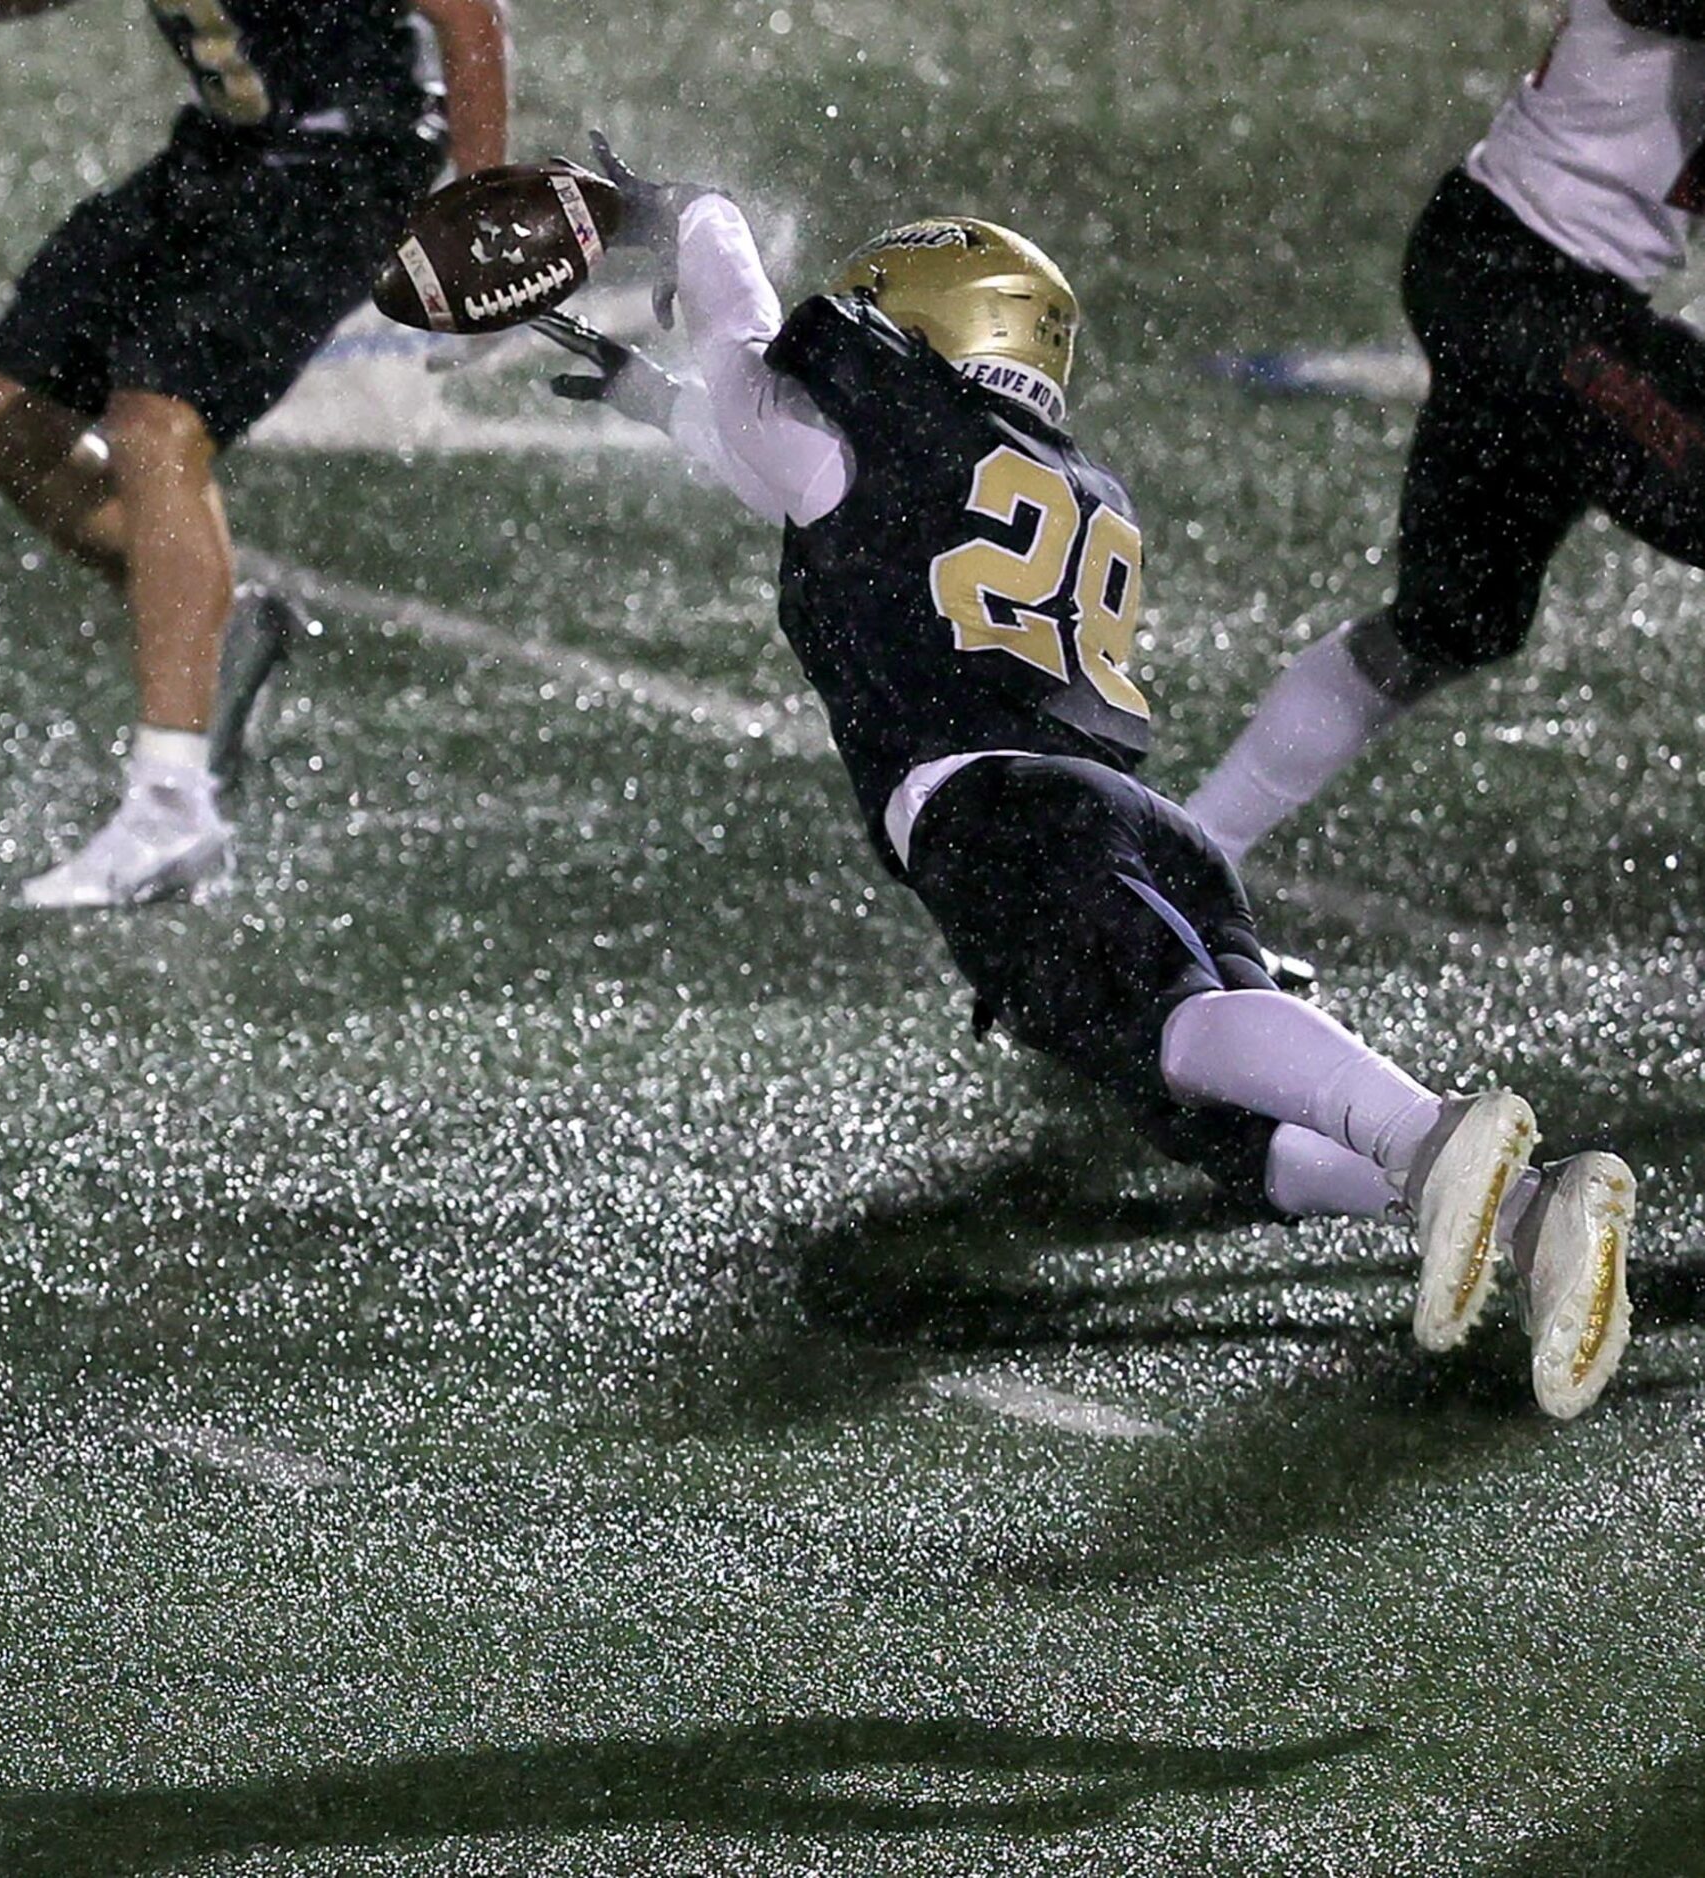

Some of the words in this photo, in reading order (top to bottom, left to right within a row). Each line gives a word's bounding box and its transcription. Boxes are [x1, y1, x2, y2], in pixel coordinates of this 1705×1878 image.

[959, 362, 1029, 393] LEAVE
[1027, 380, 1052, 407] NO
[928, 444, 1151, 721] 28
